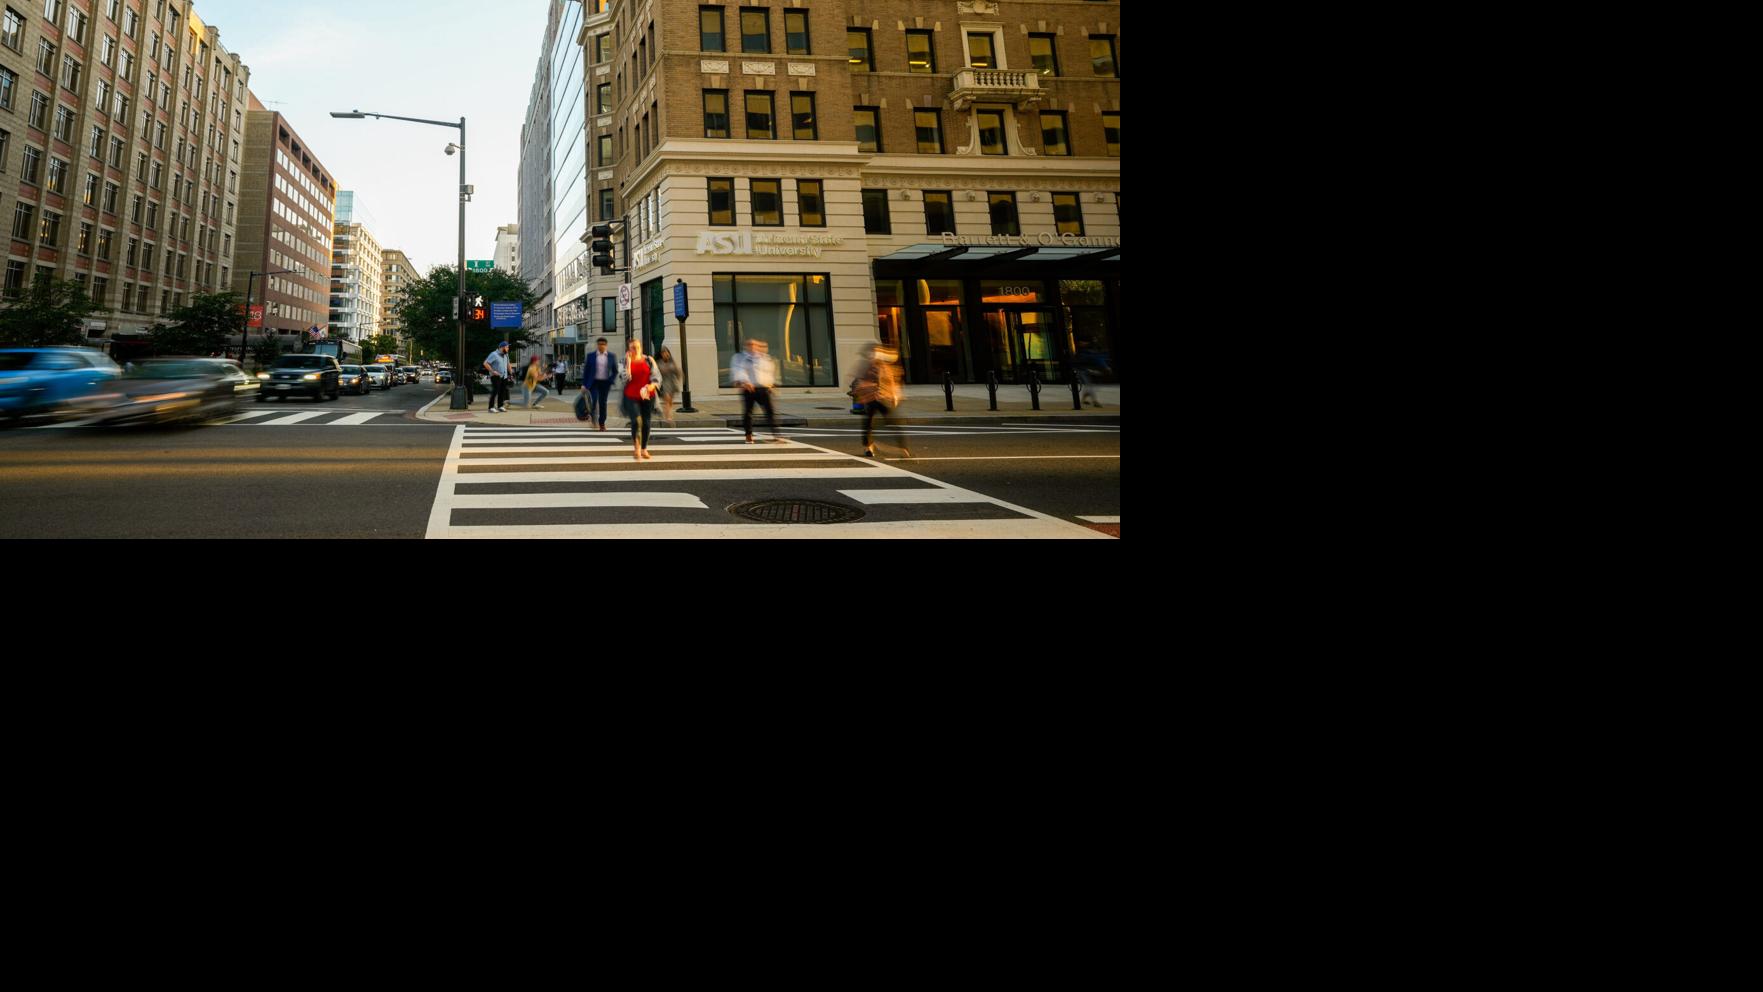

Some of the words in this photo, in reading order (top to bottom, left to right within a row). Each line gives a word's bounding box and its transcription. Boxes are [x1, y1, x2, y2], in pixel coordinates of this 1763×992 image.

[697, 231, 752, 255] ASU
[941, 231, 1010, 247] Barrett
[1019, 232, 1031, 247] &
[756, 244, 822, 257] University
[999, 286, 1030, 296] 1800
[474, 309, 484, 320] 34
